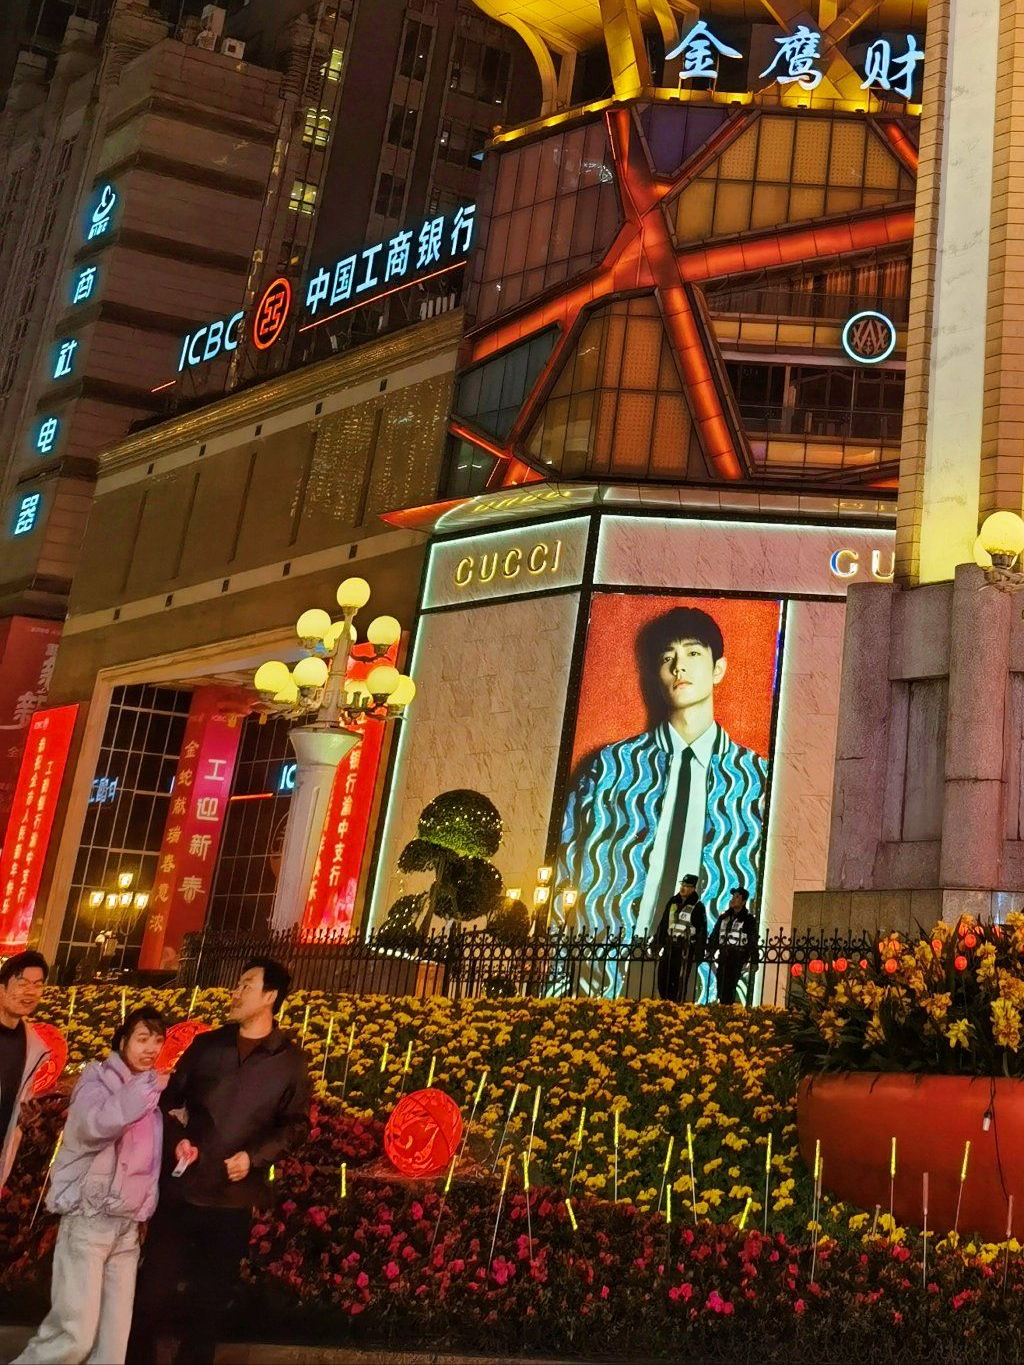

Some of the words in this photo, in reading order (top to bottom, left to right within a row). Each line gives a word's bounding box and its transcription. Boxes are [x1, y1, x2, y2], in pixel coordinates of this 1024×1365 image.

[665, 20, 926, 100] 金鹰财
[306, 204, 476, 315] 中国工商银行
[178, 311, 244, 372] ICBC
[15, 266, 97, 535] 商社电器
[455, 540, 562, 586] GUCCI
[149, 739, 200, 933] 金蛇献瑞春意浓
[178, 758, 228, 904] 工迎新春
